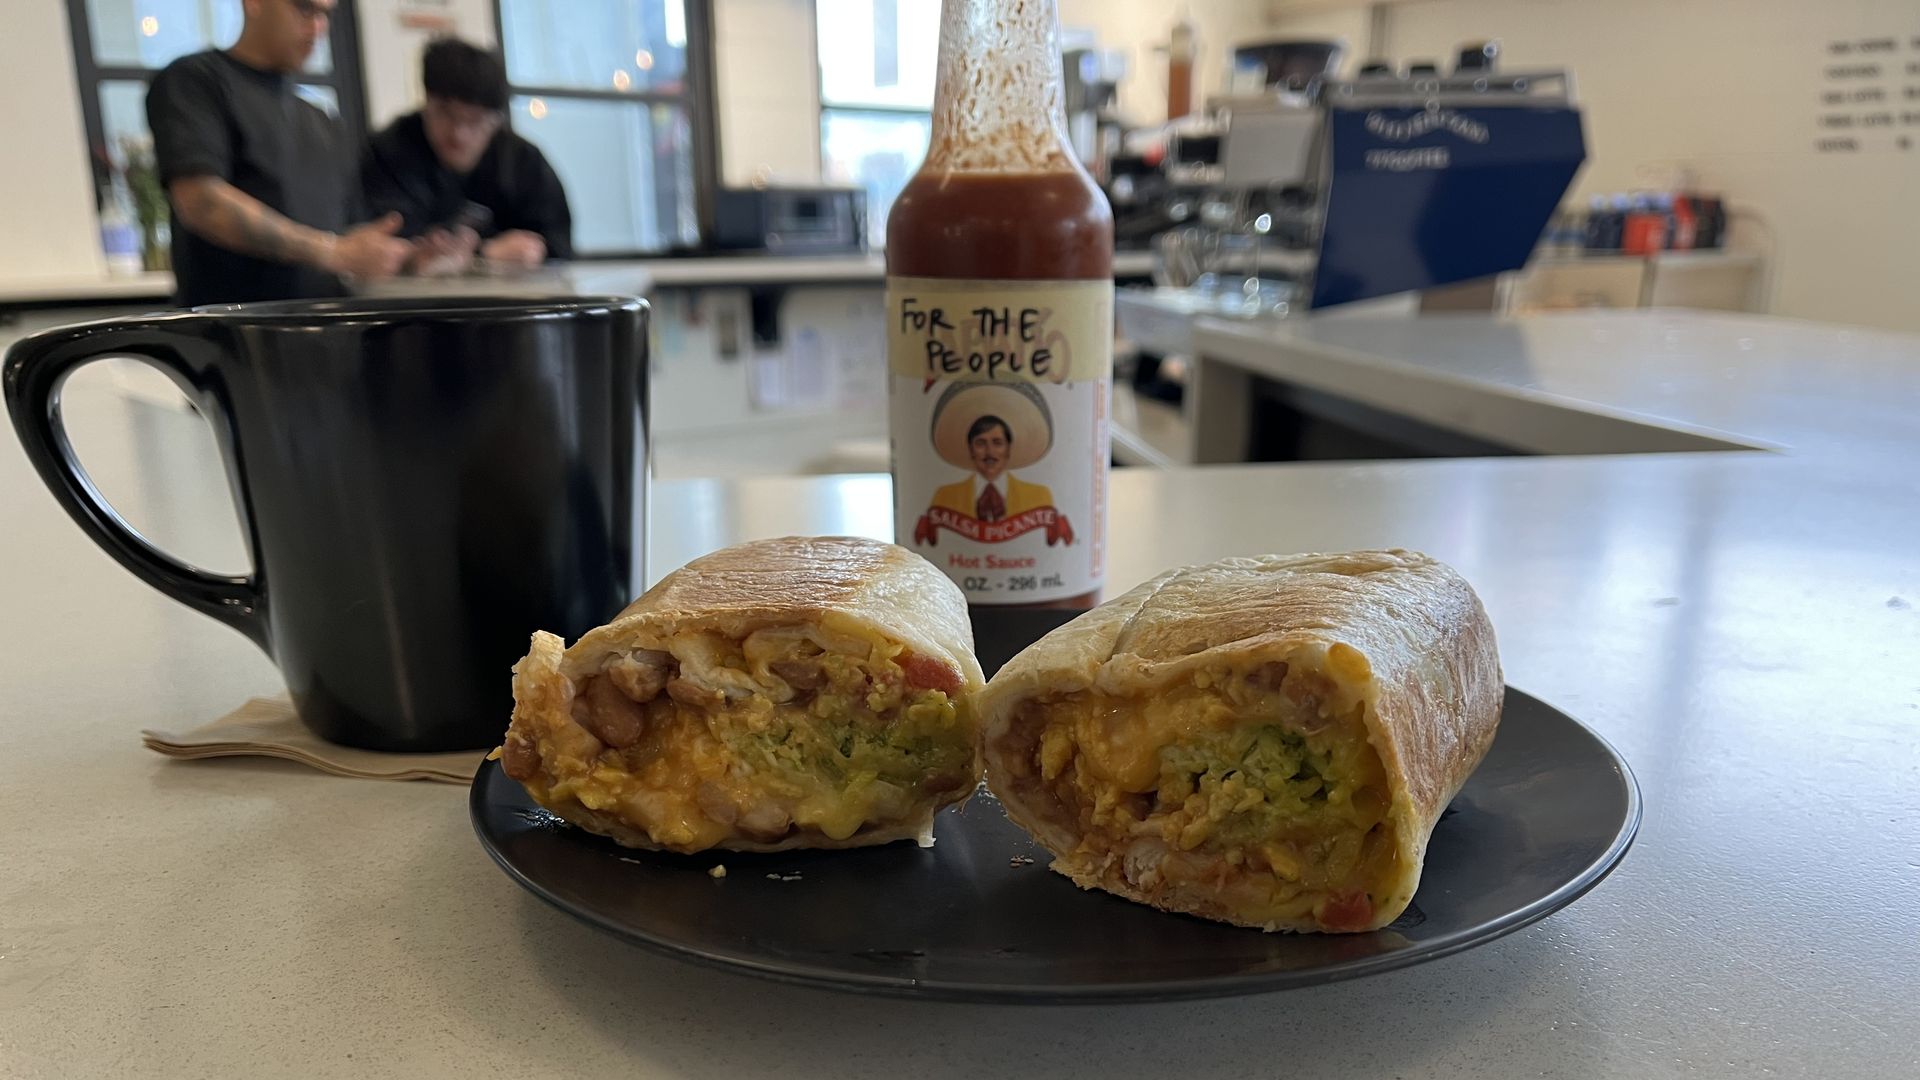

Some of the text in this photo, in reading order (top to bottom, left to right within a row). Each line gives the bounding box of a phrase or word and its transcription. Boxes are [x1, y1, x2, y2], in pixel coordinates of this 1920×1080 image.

[901, 298, 1040, 342] FOR THE
[926, 339, 1052, 380] PEOPLE
[929, 508, 1057, 540] SALSA PICANTE
[948, 553, 1036, 569] Hot Sauce
[1007, 575, 1038, 591] 296
